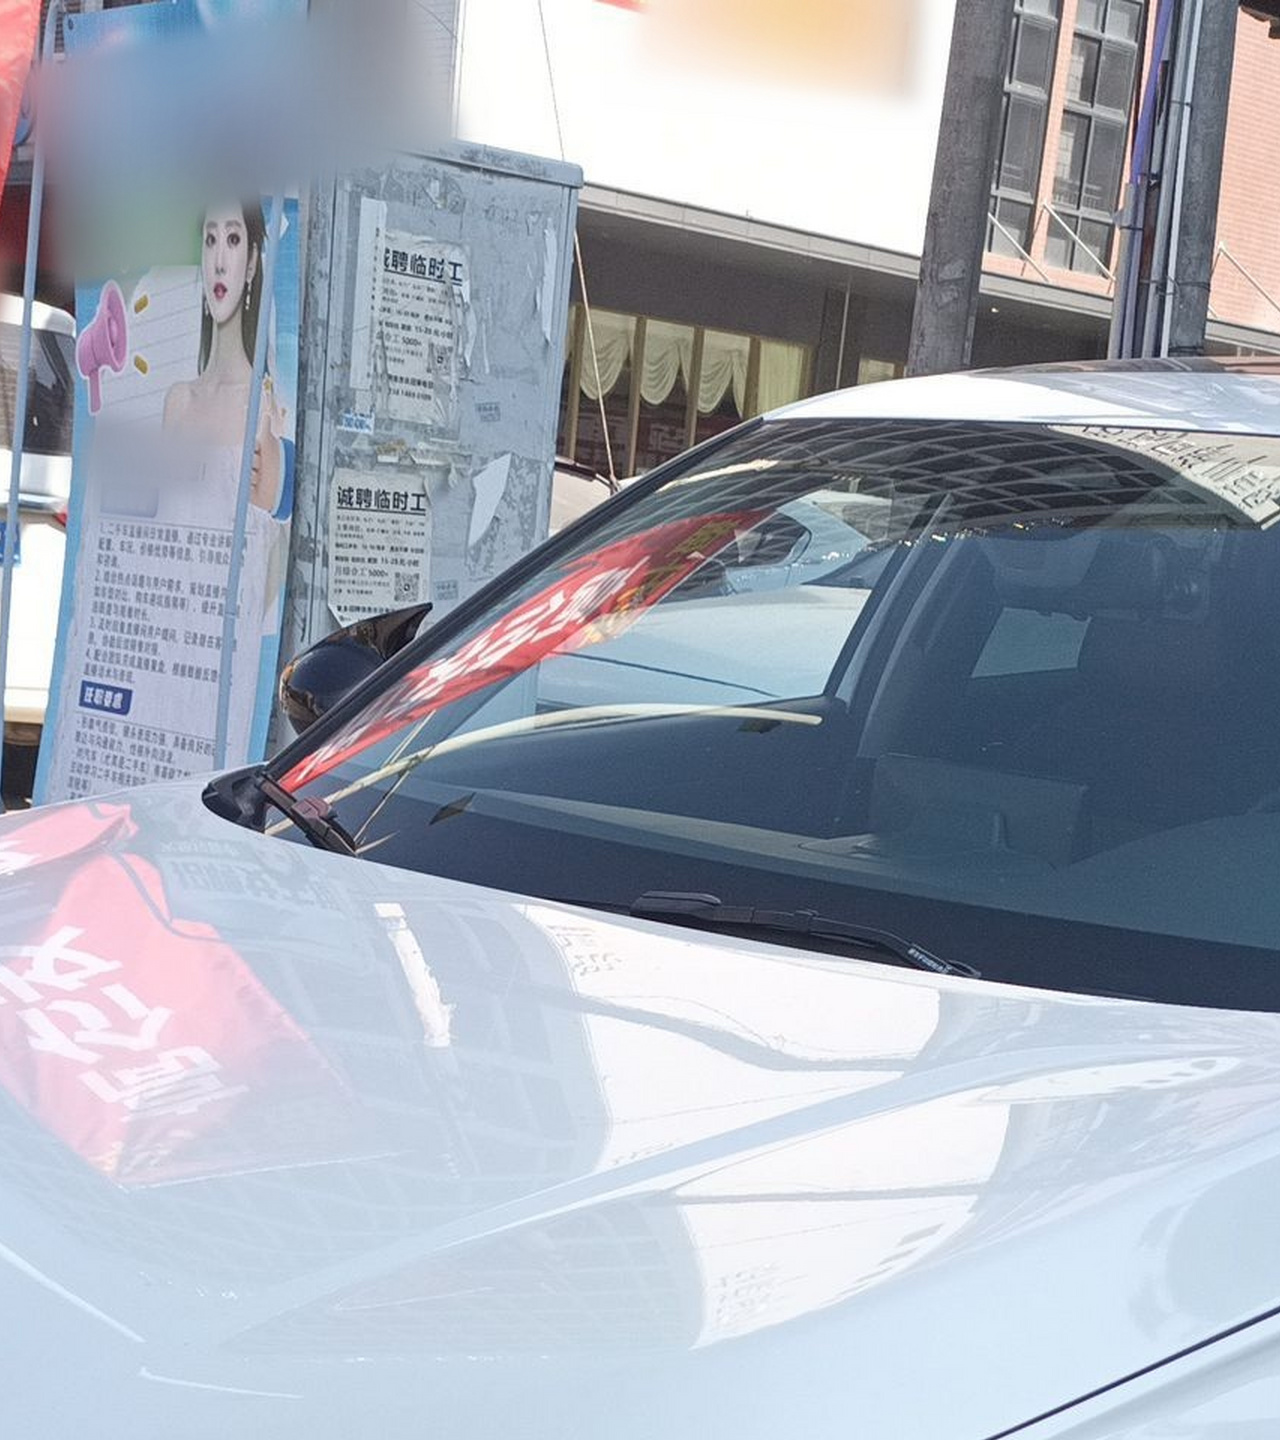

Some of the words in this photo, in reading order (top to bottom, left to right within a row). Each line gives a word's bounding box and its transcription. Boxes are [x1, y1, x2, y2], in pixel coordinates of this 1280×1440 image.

[336, 486, 427, 512] 诚聘临时工
